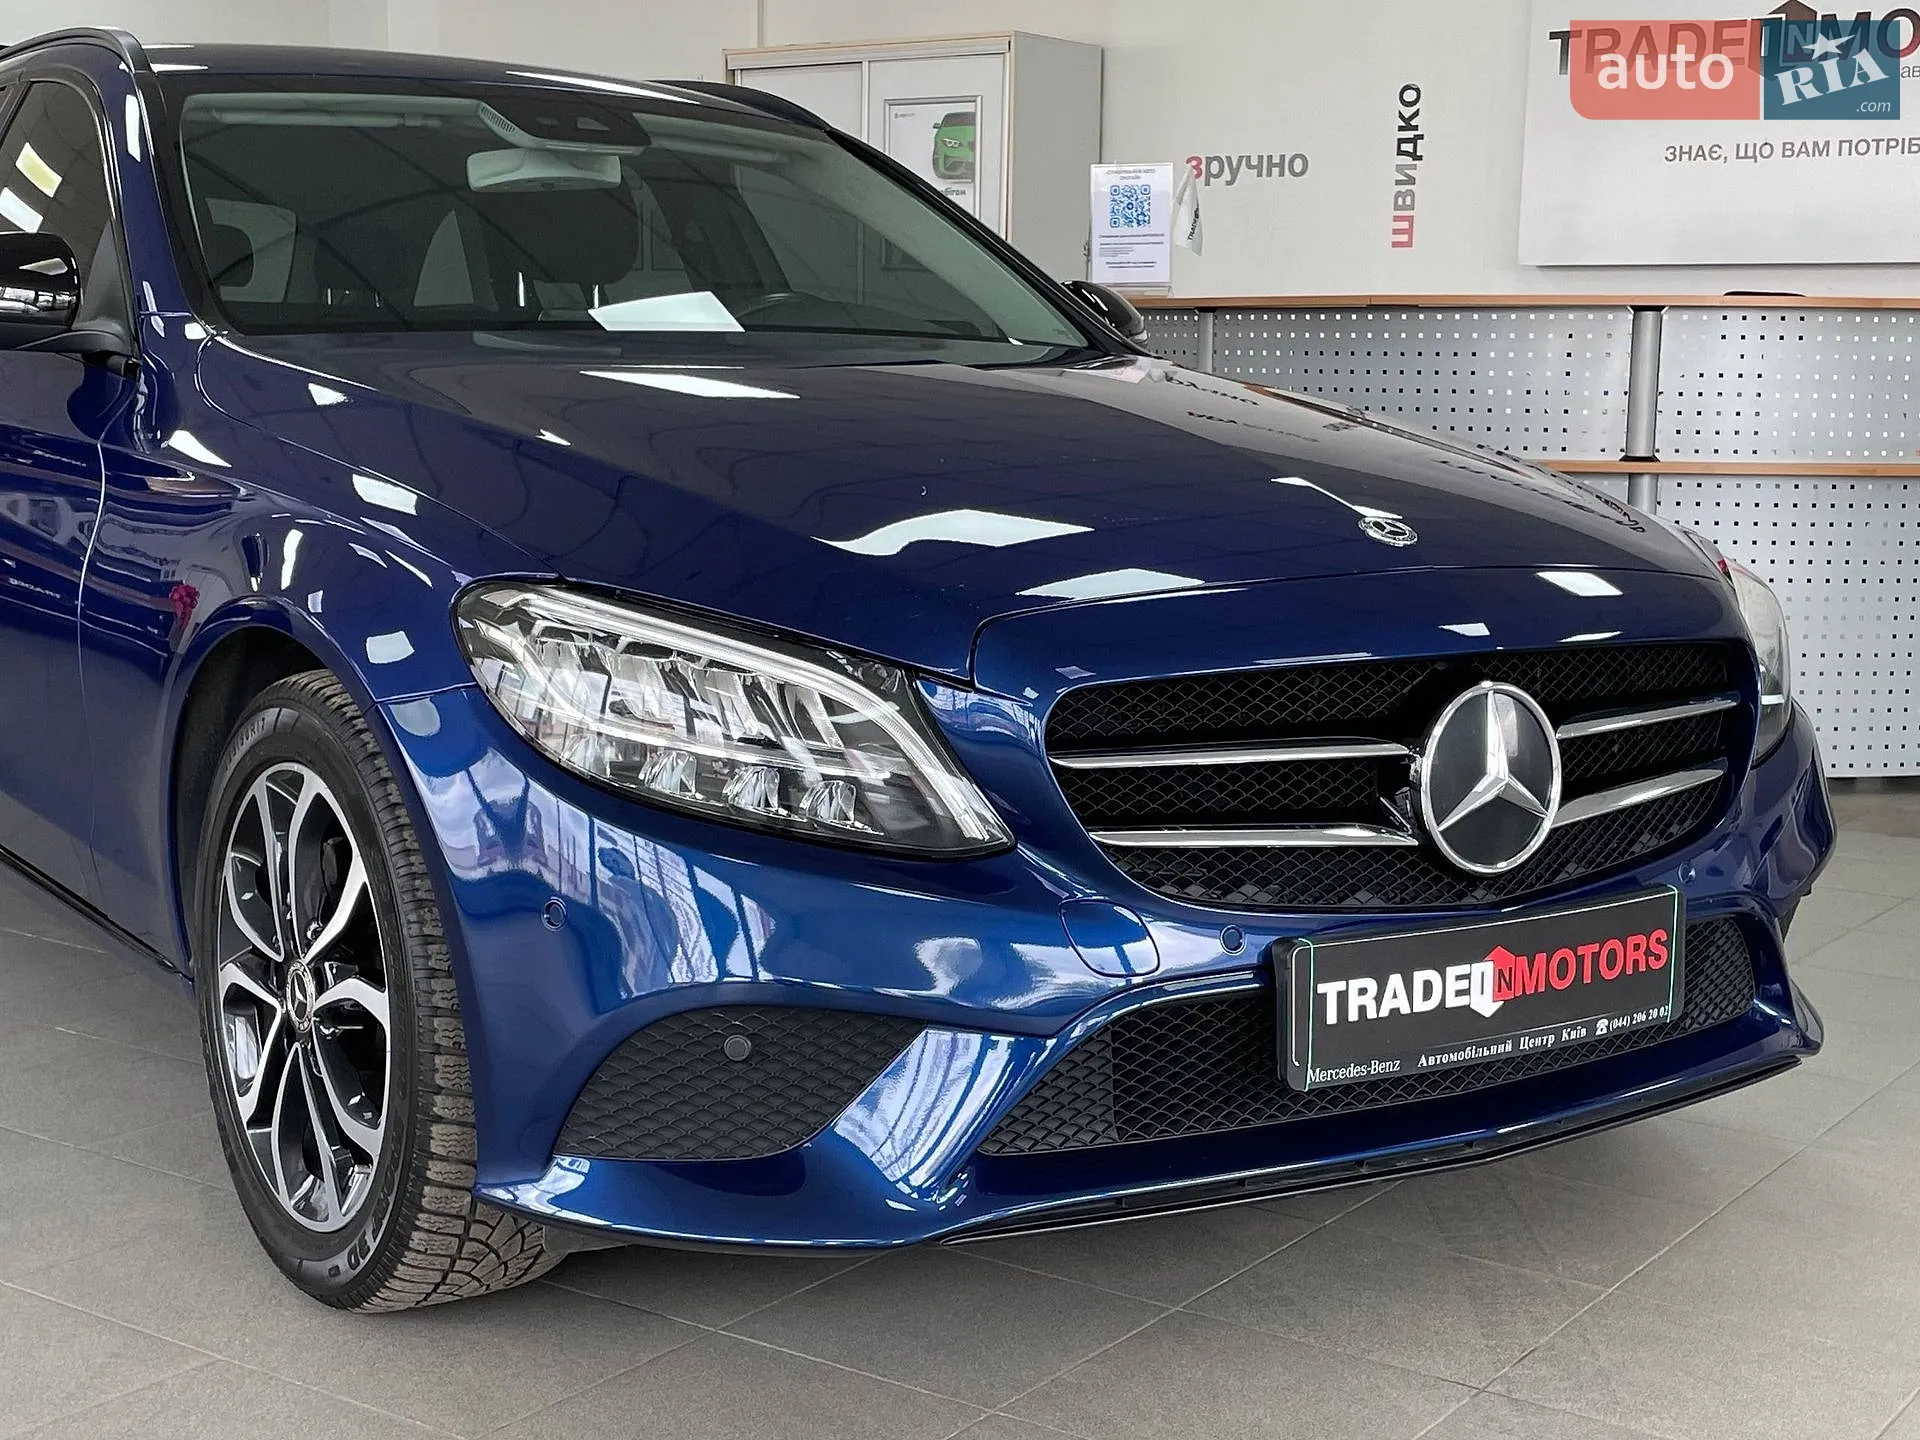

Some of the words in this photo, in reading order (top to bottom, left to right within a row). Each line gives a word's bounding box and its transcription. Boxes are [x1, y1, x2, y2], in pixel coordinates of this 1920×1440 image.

[1664, 144, 1728, 164] ЗНАЄ,
[1735, 142, 1774, 163] ЩО
[1781, 140, 1830, 159] ВАМ
[1417, 1040, 1513, 1067] Автомобільний
[1519, 1033, 1556, 1051] Центр
[1560, 1027, 1587, 1042] Київ
[1309, 1059, 1401, 1083] Mercedes-Benz
